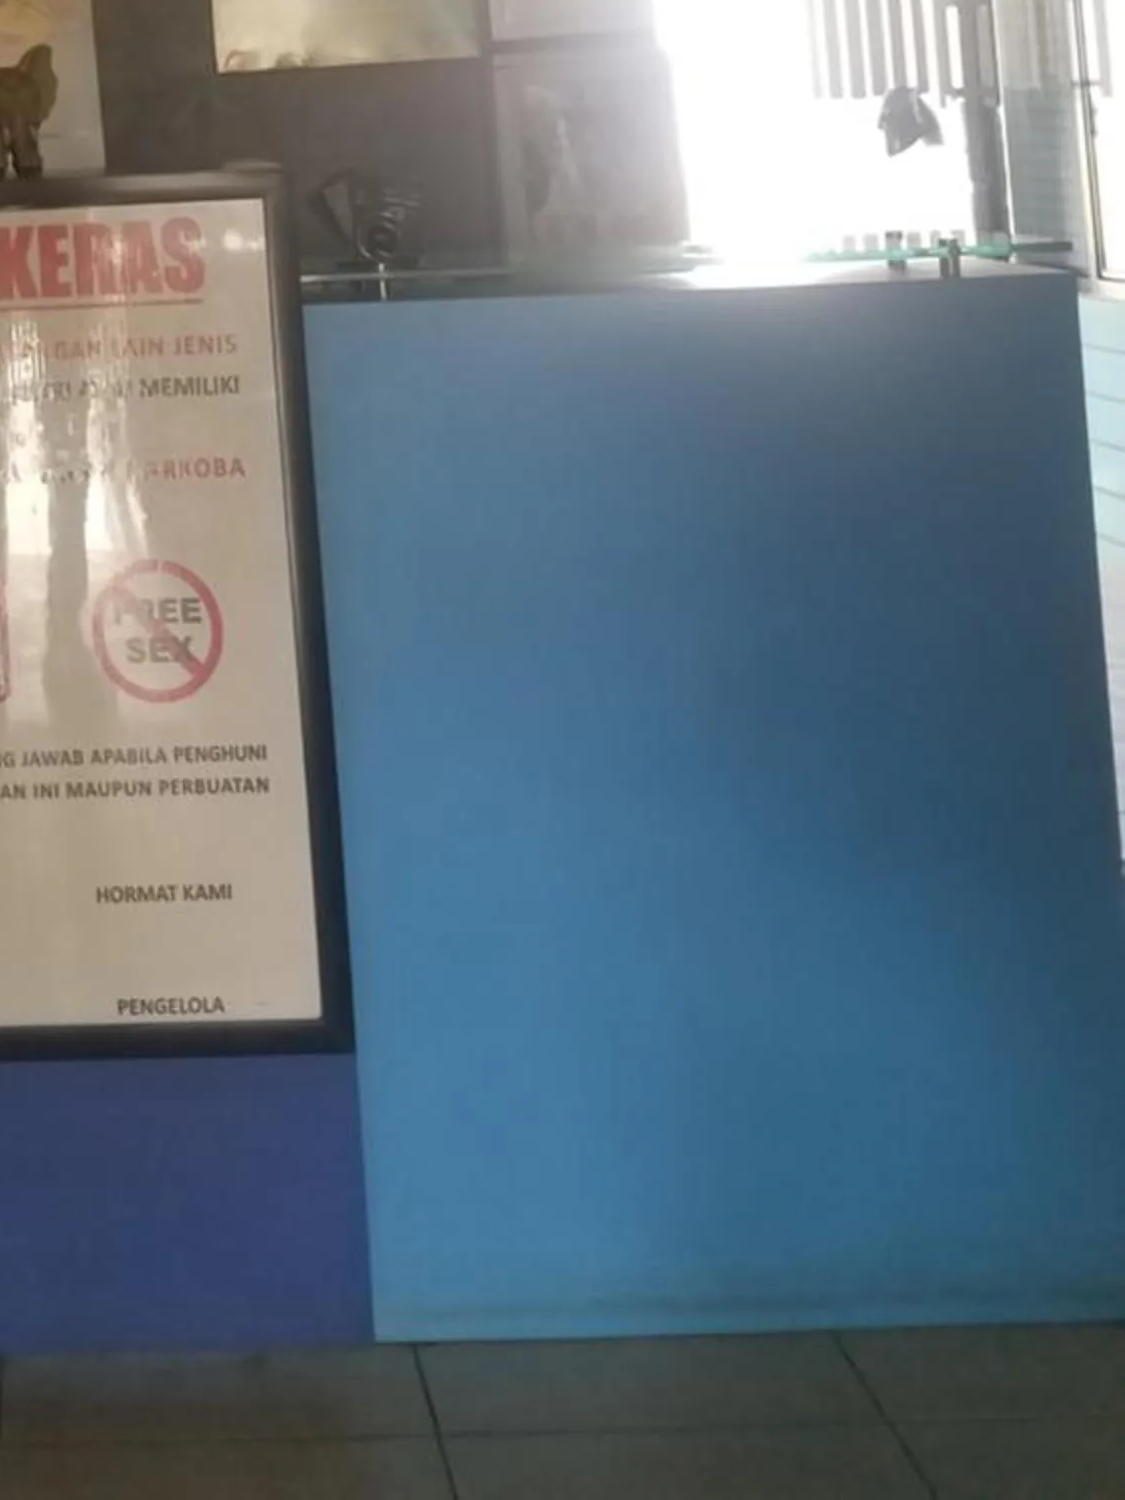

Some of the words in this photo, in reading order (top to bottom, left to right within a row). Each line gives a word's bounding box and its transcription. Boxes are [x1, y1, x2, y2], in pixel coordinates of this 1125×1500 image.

[174, 333, 238, 356] JENIS
[139, 375, 241, 398] MEMILIKI
[126, 635, 193, 664] SEX
[22, 749, 84, 769] JAWAB
[91, 746, 168, 767] APABILA
[173, 743, 268, 764] PENGHUNI
[32, 781, 60, 800] INI
[65, 778, 152, 799] MAUPUN
[159, 775, 271, 797] PERBUATAN
[96, 884, 178, 904] HORMAT
[182, 883, 233, 901] KAMI
[117, 996, 225, 1016] PENGELOLA
